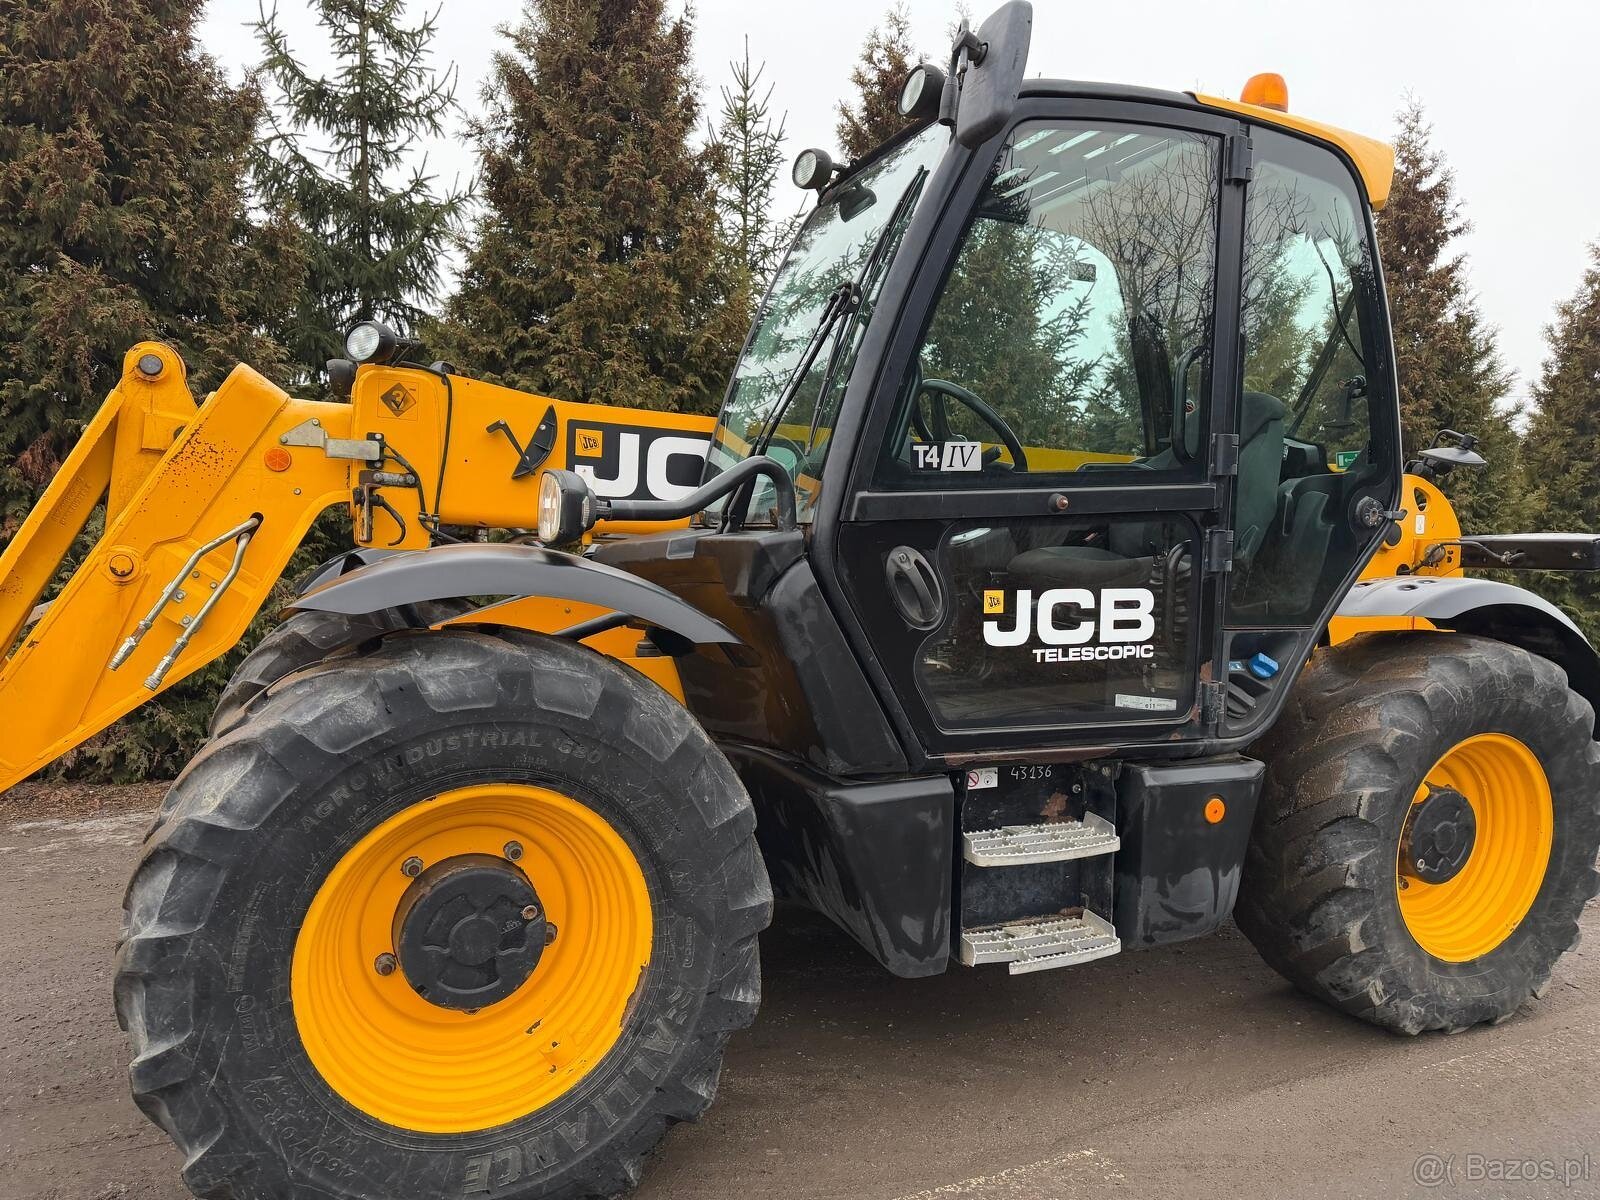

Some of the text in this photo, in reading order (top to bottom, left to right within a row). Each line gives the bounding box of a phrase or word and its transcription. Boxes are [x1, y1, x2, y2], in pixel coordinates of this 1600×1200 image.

[582, 435, 599, 450] JCB
[913, 445, 977, 468] T4 IV
[575, 433, 710, 500] JC
[983, 588, 1155, 647] JCB
[1032, 645, 1154, 663] TELESCOPIC
[300, 771, 368, 835] AGRO
[370, 726, 545, 784] INDUSTRIAL
[1010, 764, 1053, 780] 43136
[463, 1015, 678, 1194] ALLIANCE
